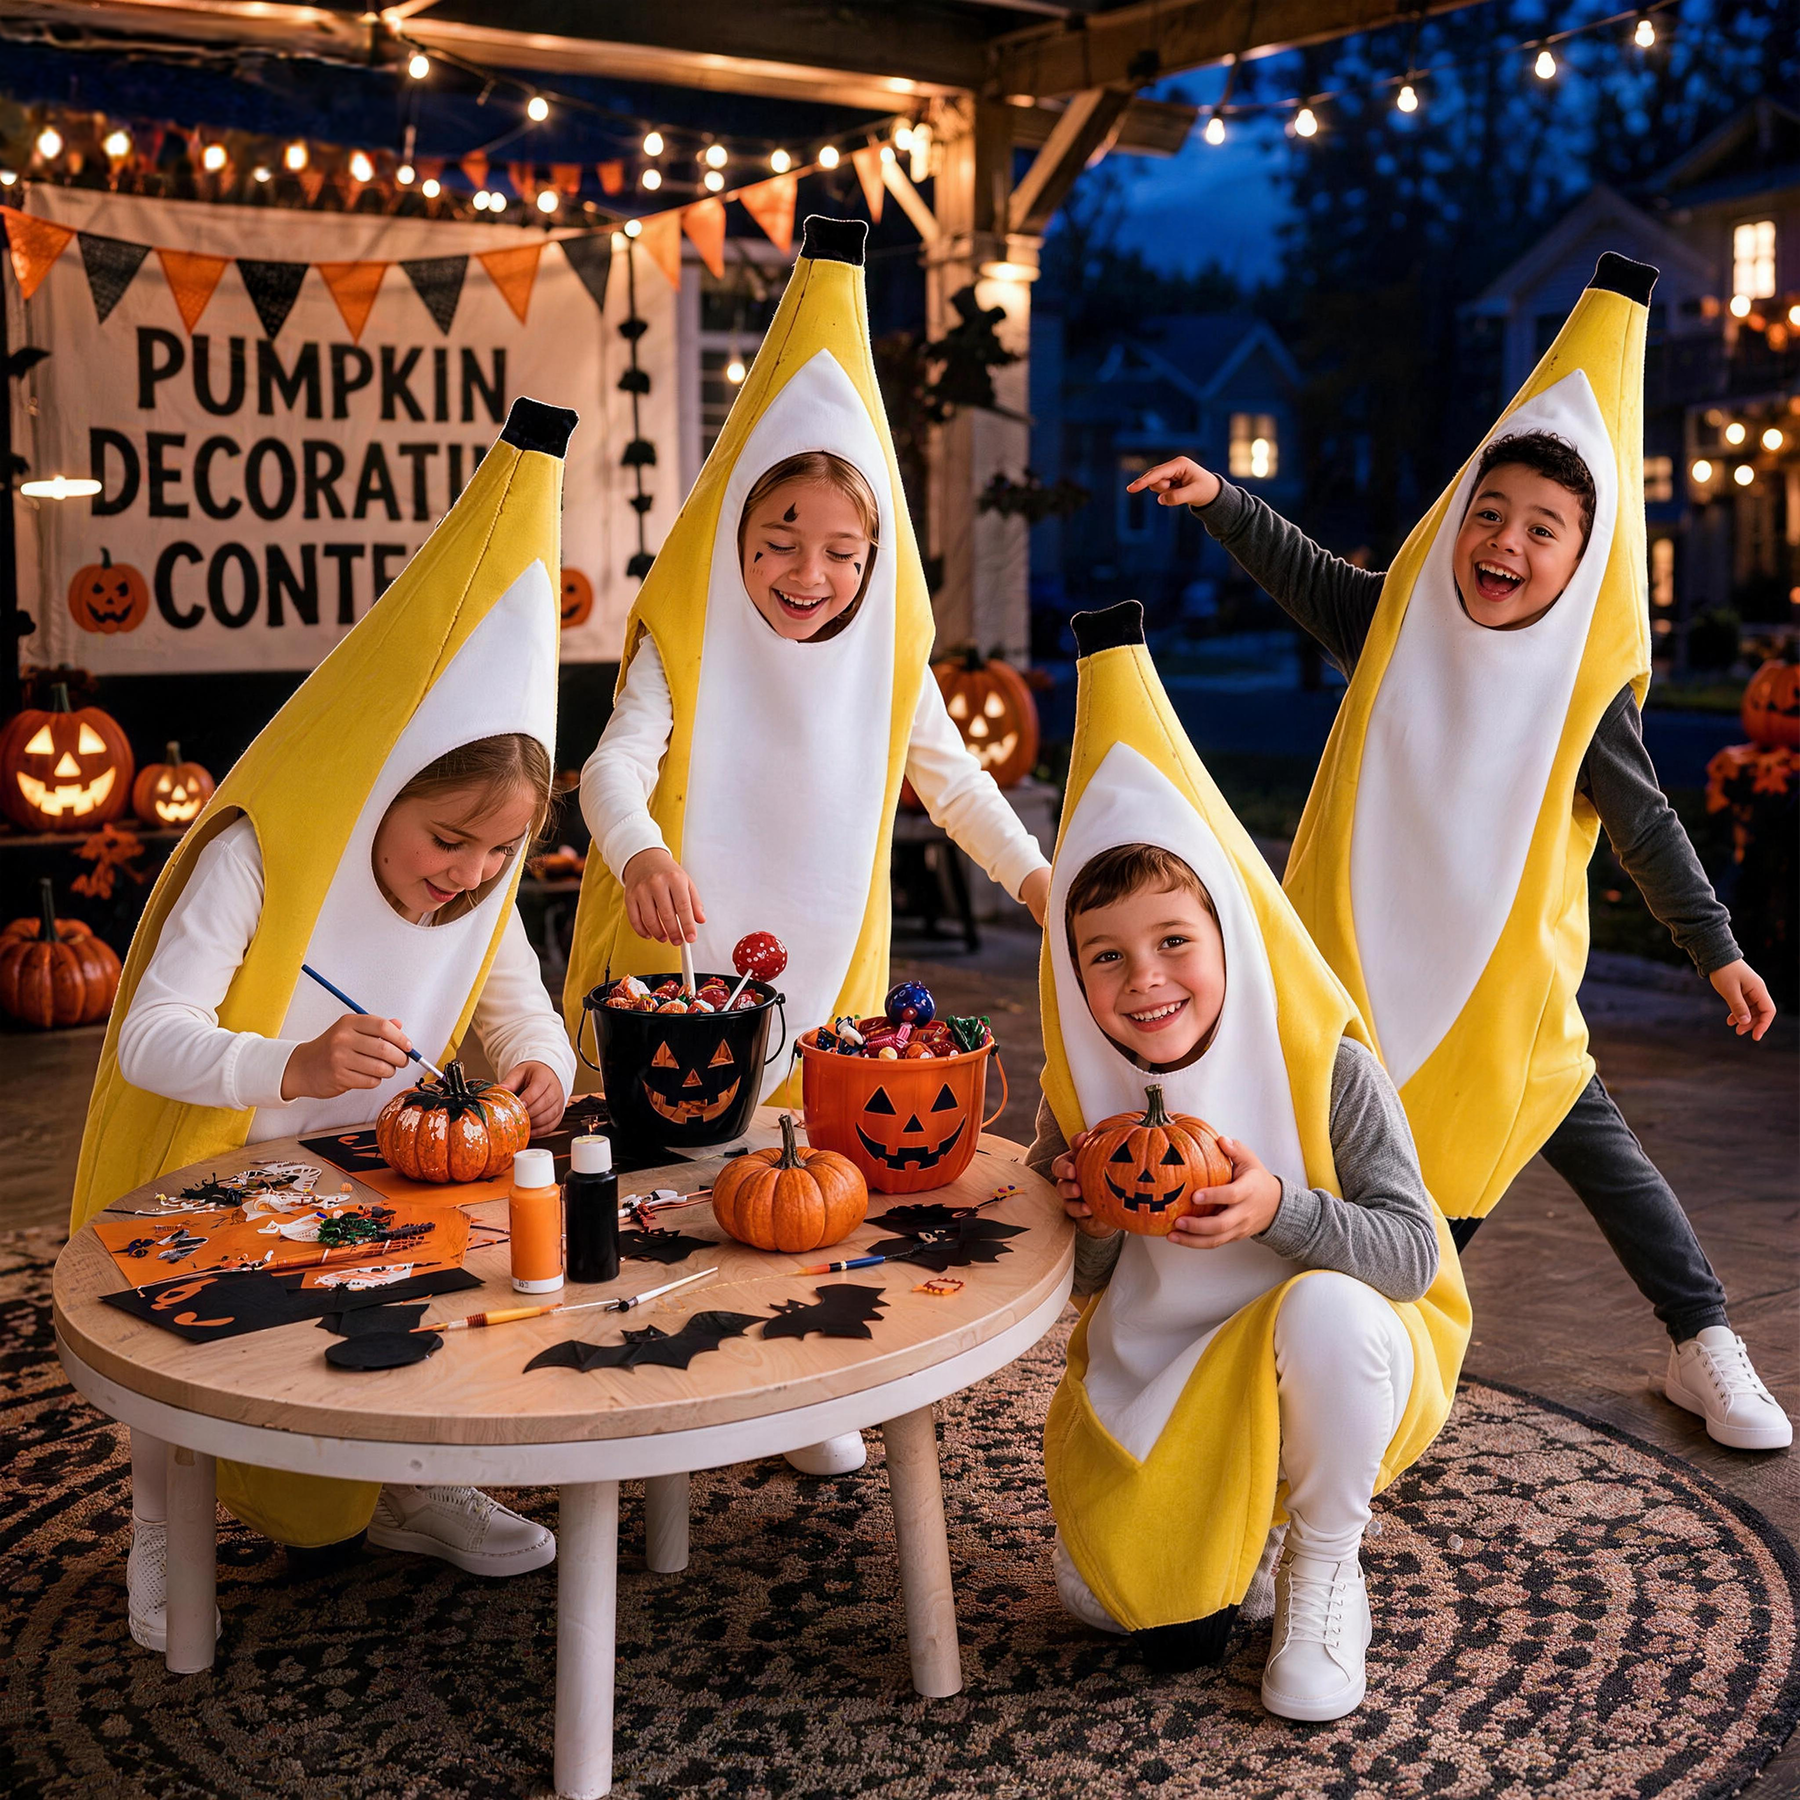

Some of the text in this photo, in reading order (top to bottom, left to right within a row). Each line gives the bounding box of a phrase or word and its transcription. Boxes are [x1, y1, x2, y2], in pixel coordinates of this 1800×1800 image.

[136, 326, 507, 424] PUMPKIN
[88, 426, 489, 522] DECORATI
[153, 540, 423, 631] CONTE
